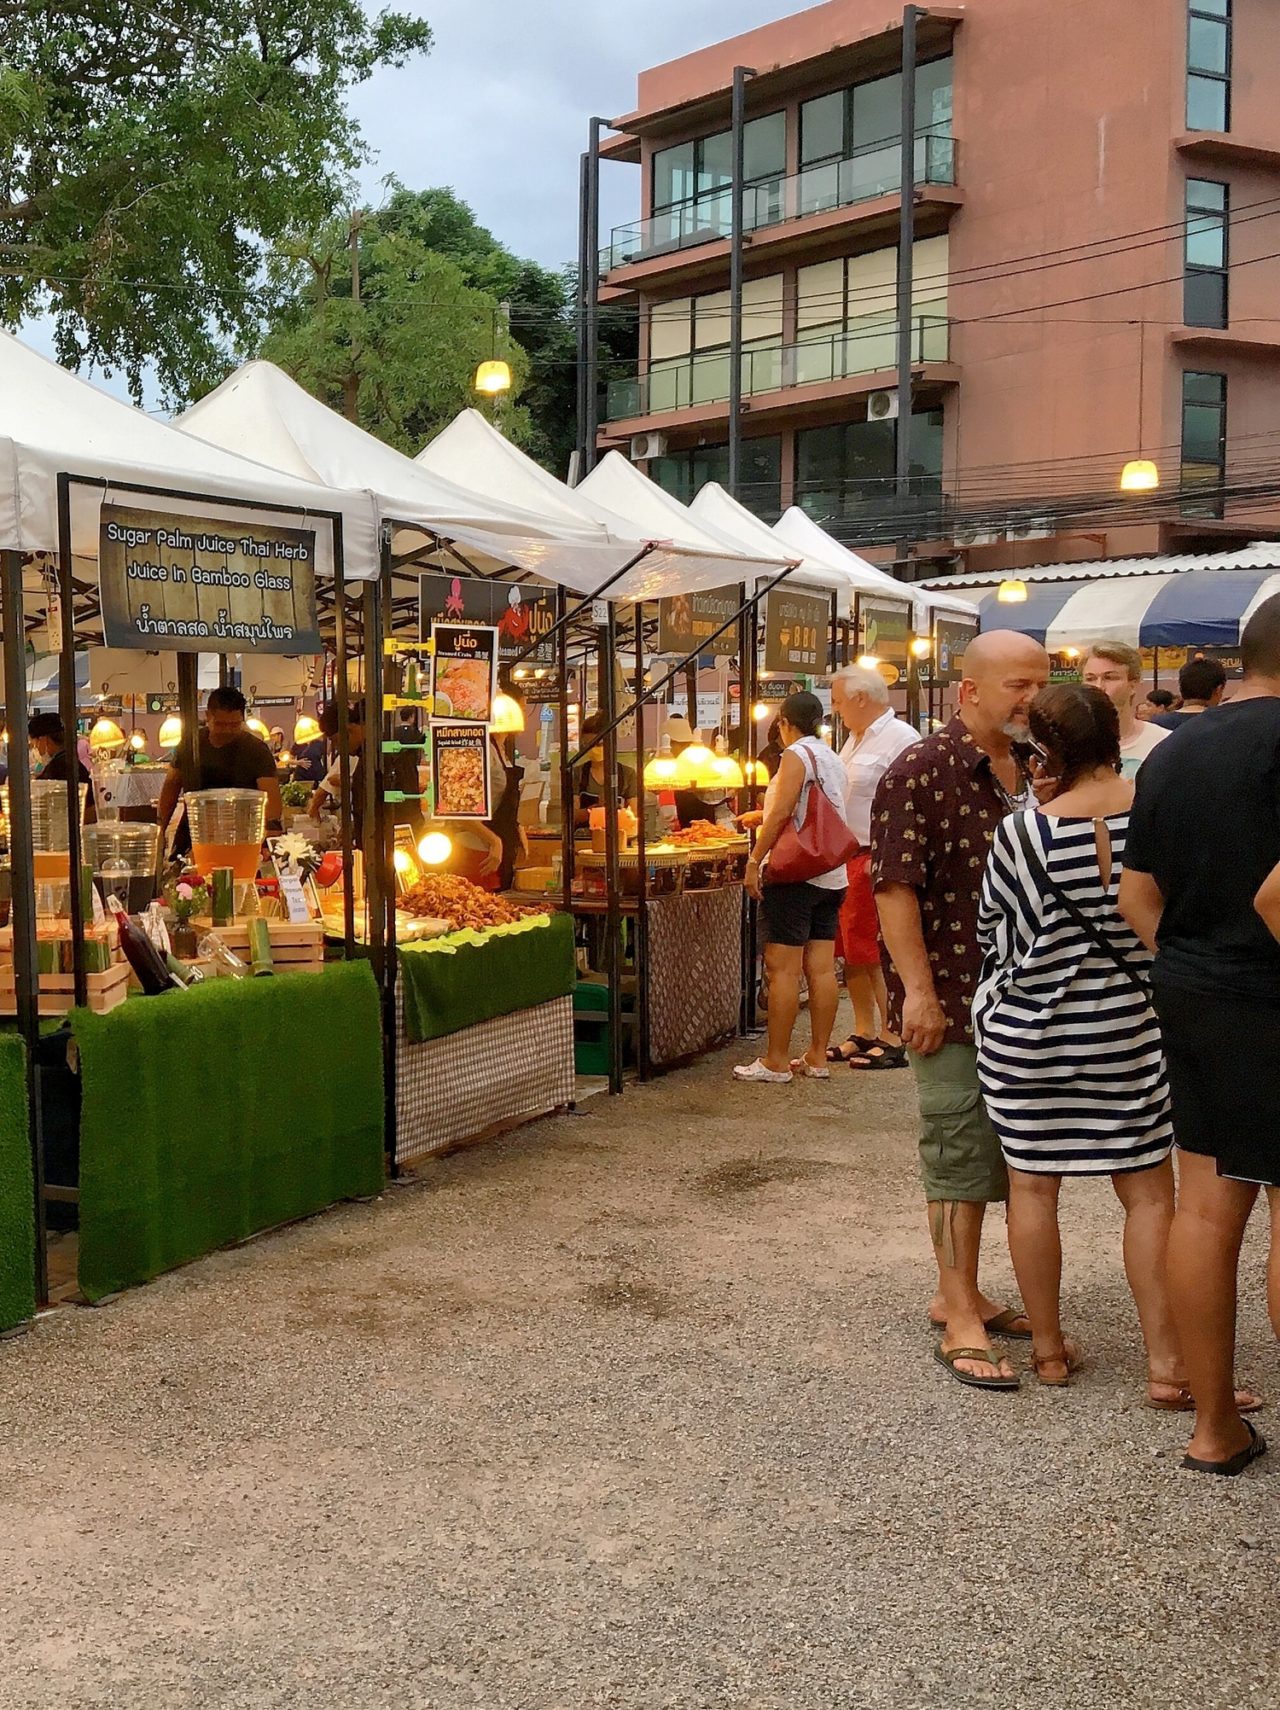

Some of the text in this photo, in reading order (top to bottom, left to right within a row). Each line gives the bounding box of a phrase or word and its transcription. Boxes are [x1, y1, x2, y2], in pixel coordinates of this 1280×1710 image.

[107, 523, 308, 560] Sugar Palm Juice Thai Herb
[128, 562, 292, 590] Juice In Bamboo Glass
[136, 605, 293, 646] น้ำตาลสด น้ำสมุนไพร
[594, 605, 607, 618] S22
